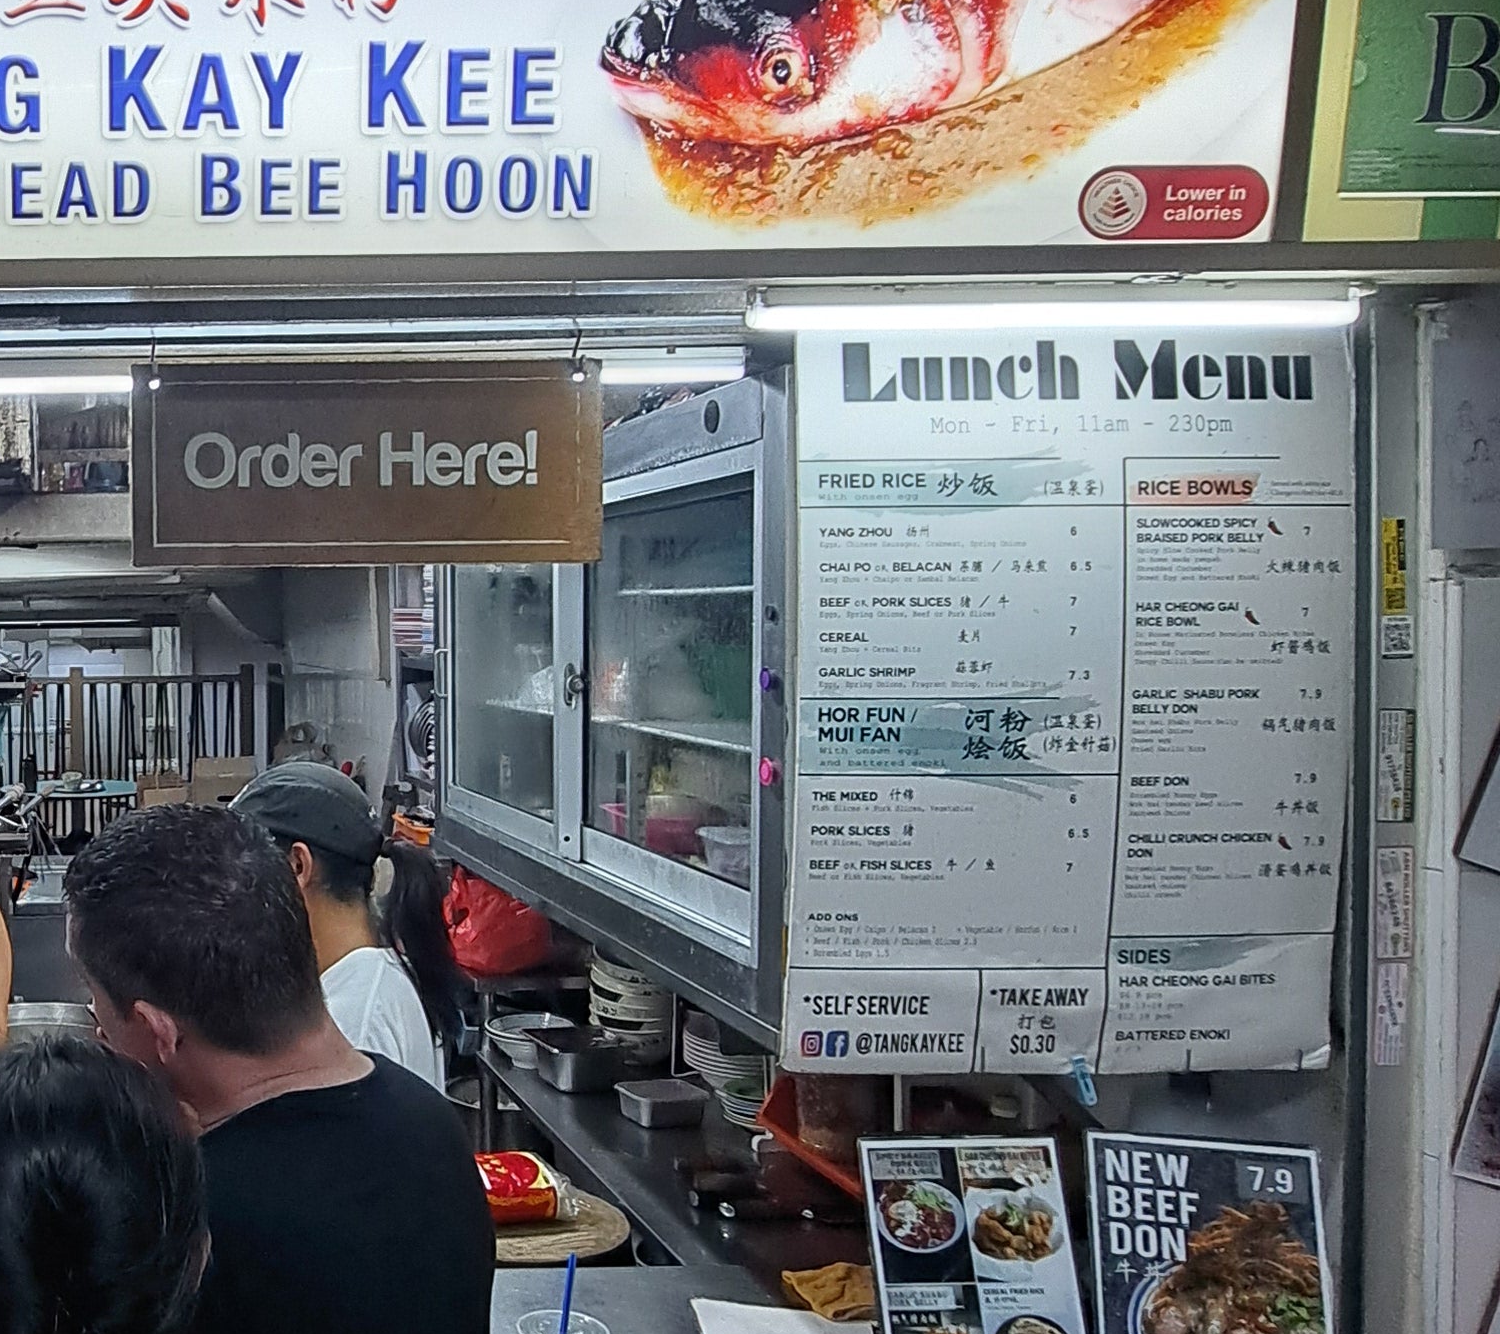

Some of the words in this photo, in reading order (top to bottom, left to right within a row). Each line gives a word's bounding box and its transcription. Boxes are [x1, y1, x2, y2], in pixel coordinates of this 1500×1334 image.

[107, 43, 303, 134] KAY
[365, 40, 562, 127] KEE
[199, 154, 345, 217] BEE
[385, 151, 594, 215] HOON
[1165, 185, 1224, 201] Lower
[1229, 184, 1247, 200] in
[1163, 205, 1243, 221] calories
[842, 340, 1079, 402] Lunch
[1113, 339, 1313, 400] Menu
[930, 417, 971, 433] Mon
[1011, 415, 1060, 435] Fri,
[1078, 414, 1129, 433] 11am
[1169, 414, 1233, 437] 230pm
[184, 430, 363, 489] Order
[379, 429, 539, 487] Here!
[818, 474, 875, 488] FRIED
[882, 473, 927, 488] RICE
[937, 472, 999, 498] 炒饭
[1137, 480, 1181, 496] RICE
[1186, 479, 1253, 496] BOWLS
[1136, 519, 1220, 529] SLOWCOOKED
[1223, 519, 1257, 529] SPICY
[819, 527, 855, 538] YANG
[858, 527, 893, 538] ZHOU
[1070, 526, 1077, 537] 6
[1303, 527, 1311, 536] 7
[1136, 533, 1189, 543] BRAISED
[1191, 533, 1224, 543] PORK
[1227, 533, 1264, 543] BELLY
[819, 562, 851, 572] CHAI
[854, 562, 872, 572] PO
[892, 562, 952, 572] BELACAN
[1070, 561, 1092, 571] 6.5
[819, 597, 851, 608] BEEF
[872, 597, 906, 608] PORK
[909, 597, 952, 608] SLICES
[1070, 596, 1077, 607] 7
[1135, 602, 1161, 612] HAR
[1164, 602, 1215, 612] CHEONG
[1217, 602, 1239, 612] GAI
[1301, 607, 1309, 617] 7
[1136, 617, 1162, 627] RICE
[1166, 617, 1200, 627] BOWL
[1069, 626, 1077, 636] 7
[819, 632, 869, 643] CEREAL
[818, 667, 866, 678] GARLIC
[868, 667, 916, 678] SHRIMP
[1068, 670, 1090, 681] 7.3
[1131, 689, 1177, 699] GARLIC
[1183, 689, 1225, 699] SHABU
[1227, 689, 1260, 699] PORK
[1300, 689, 1323, 699] 7.9
[1131, 704, 1172, 714] BELLY
[1172, 704, 1198, 714] DON
[817, 707, 860, 723] HOR
[866, 707, 907, 723] FUN
[964, 706, 1032, 733] 河粉
[817, 727, 855, 743] MUI
[860, 727, 901, 743] FAN
[962, 736, 1031, 761] 烩饭
[1130, 777, 1160, 786] BEEF
[1163, 777, 1189, 786] DON
[1294, 773, 1317, 784] 7.9
[812, 791, 837, 802] THE
[840, 791, 878, 802] MIXED
[1069, 793, 1077, 804] 6
[811, 826, 844, 836] PORK
[848, 826, 891, 836] SLICES
[1067, 828, 1090, 839] 6.5
[1127, 833, 1165, 844] CHILLI
[1168, 833, 1218, 844] CRUNCH
[1220, 833, 1272, 844] CHICKEN
[1303, 836, 1325, 847] 7.9
[1127, 848, 1153, 858] DON
[809, 859, 840, 870] BEEF
[859, 859, 888, 870] FISH
[890, 859, 932, 870] SLICES
[1066, 862, 1073, 873] 7
[807, 913, 832, 922] ADD
[834, 913, 859, 922] ONS
[1116, 949, 1172, 965] SIDES
[1119, 976, 1148, 988] HAR
[1151, 975, 1209, 987] CHEONG
[1212, 974, 1236, 986] GAI
[1239, 973, 1276, 985] BITES
[1043, 988, 1090, 1007] AWAY
[856, 995, 930, 1016] SERVICE
[1017, 1014, 1057, 1031] 打包
[1115, 1030, 1186, 1041] BATTERED
[1189, 1030, 1231, 1041] ENOKI
[855, 1033, 966, 1055] @TANGKAYKEE
[1009, 1034, 1056, 1056] $0.30
[1104, 1147, 1190, 1189] NEW
[1246, 1165, 1294, 1194] 7.9
[1107, 1184, 1200, 1227] BEEF
[1109, 1221, 1188, 1262] DON
